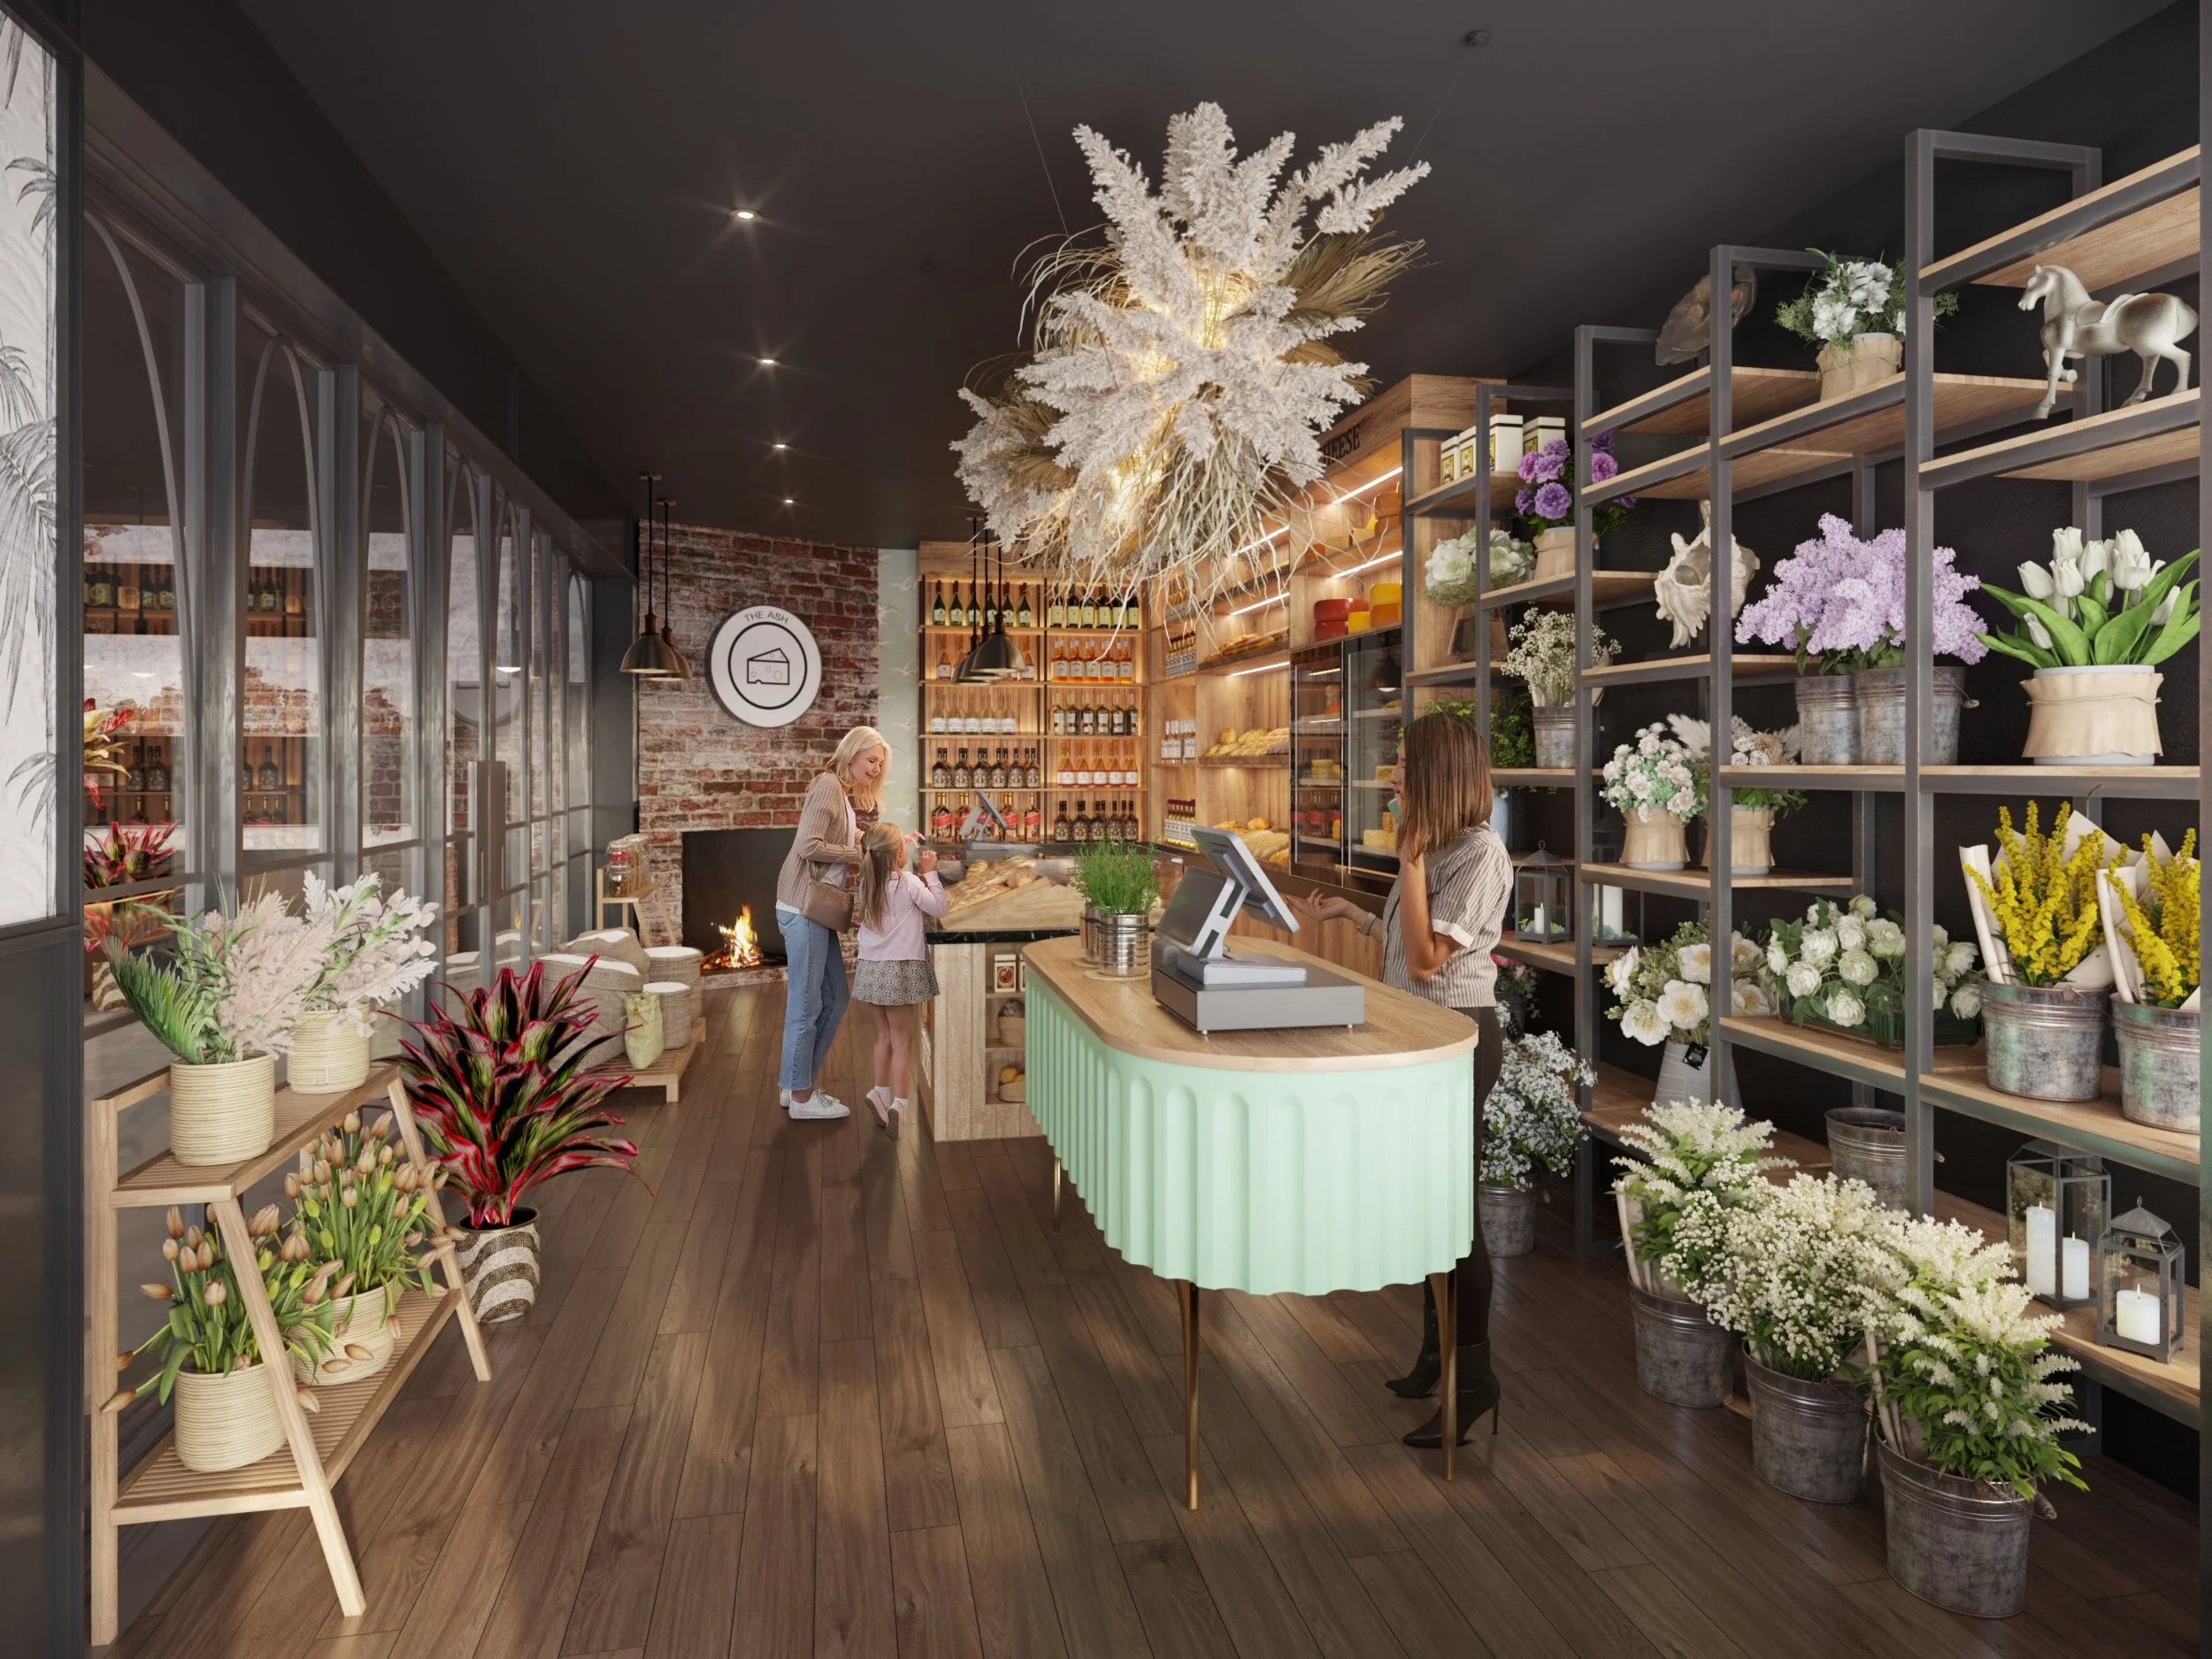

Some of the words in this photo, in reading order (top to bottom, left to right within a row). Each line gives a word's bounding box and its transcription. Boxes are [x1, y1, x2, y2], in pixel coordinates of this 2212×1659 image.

[1318, 424, 1361, 466] HEESE
[743, 611, 764, 622] THE
[767, 611, 788, 624] ASH
